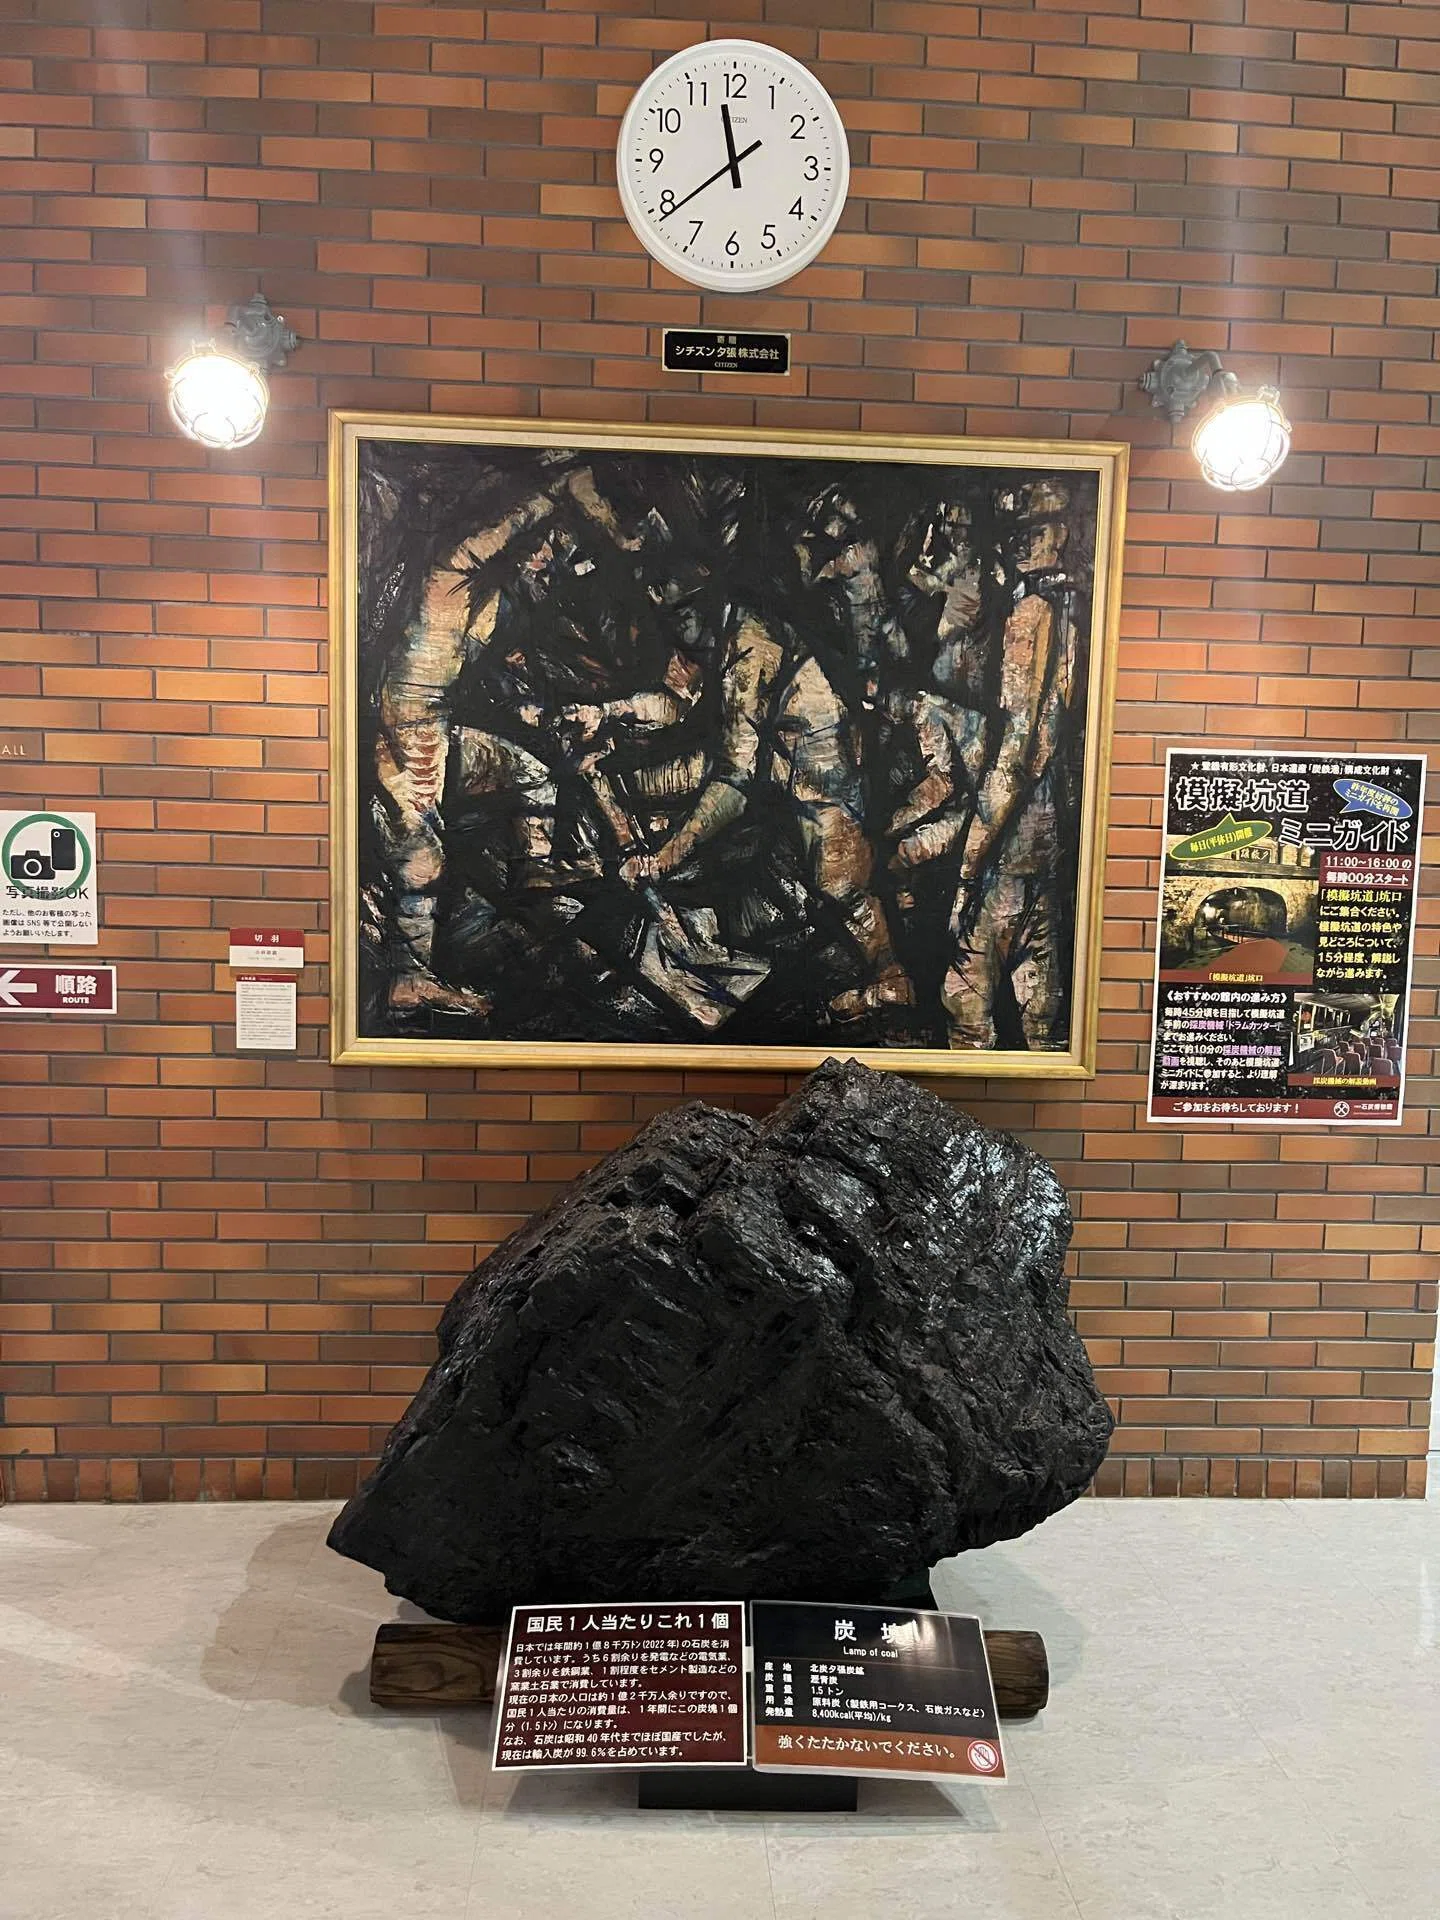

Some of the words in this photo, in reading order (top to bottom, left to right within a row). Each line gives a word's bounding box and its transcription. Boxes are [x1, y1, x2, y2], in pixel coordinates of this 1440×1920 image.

[687, 82, 708, 106] 11
[723, 73, 747, 99] 12
[768, 85, 776, 110] 1
[657, 107, 681, 133] 10
[790, 114, 806, 139] 2
[649, 148, 664, 173] 9
[803, 156, 819, 181] 3
[659, 189, 676, 215] 8
[788, 196, 804, 220] 4
[688, 220, 704, 245] 7
[725, 231, 740, 256] 6
[760, 224, 777, 249] 5
[1175, 776, 1310, 812] 模擬坑道
[1278, 817, 1410, 852] ミニガイド
[6, 885, 90, 900] 写真撮影OK
[2, 909, 92, 918] ただし、他のお客様の写った
[1319, 905, 1400, 918] にご集合ください。
[2, 929, 73, 938] ようお願いいたします。
[1319, 921, 1403, 933] 模擬坑道の特色や
[1318, 936, 1398, 948] 見どころについて、
[55, 974, 98, 995] 順路
[1316, 968, 1388, 979] ながら進みます。
[62, 996, 90, 1004] ROUTE
[1163, 1031, 1236, 1043] までお進みください。
[1173, 1101, 1300, 1114] ご参加をお待ちしております！
[843, 1646, 867, 1657] Lamp
[870, 1648, 878, 1656] of
[881, 1649, 898, 1658] coal
[765, 1707, 794, 1717] 発熱量
[778, 1735, 956, 1760] 強くたたかないでください。
